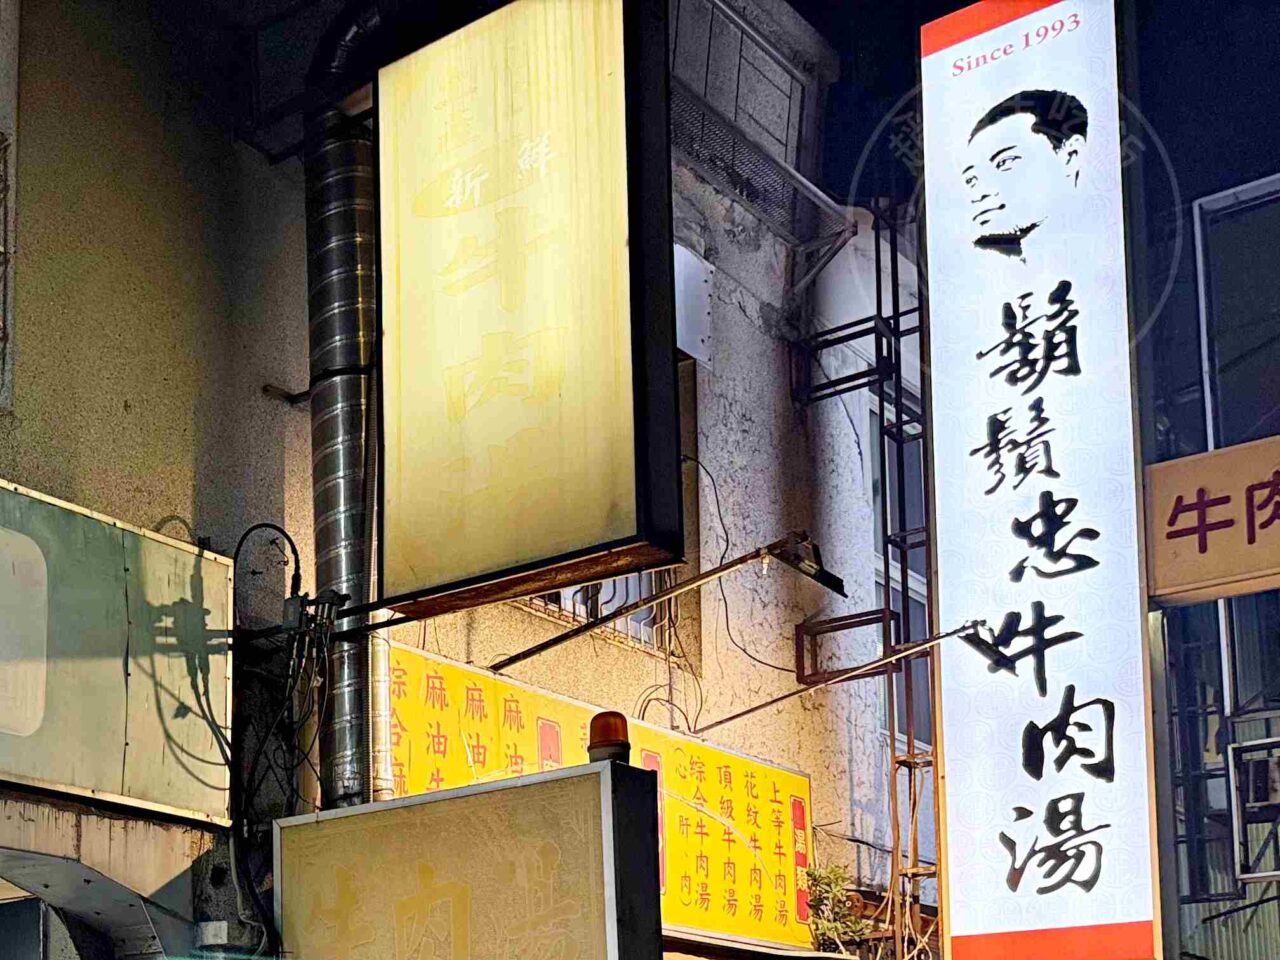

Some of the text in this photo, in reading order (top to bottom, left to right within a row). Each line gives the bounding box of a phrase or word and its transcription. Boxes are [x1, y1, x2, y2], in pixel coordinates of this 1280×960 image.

[951, 12, 1082, 78] Since 1993
[960, 279, 1117, 896] 鬍鬚忠牛肉湯
[689, 755, 712, 913] 綜合牛肉湯
[716, 764, 739, 918] 頂級牛肉湯
[743, 770, 765, 923] 花紋牛肉湯
[769, 781, 790, 928] 上等牛肉湯
